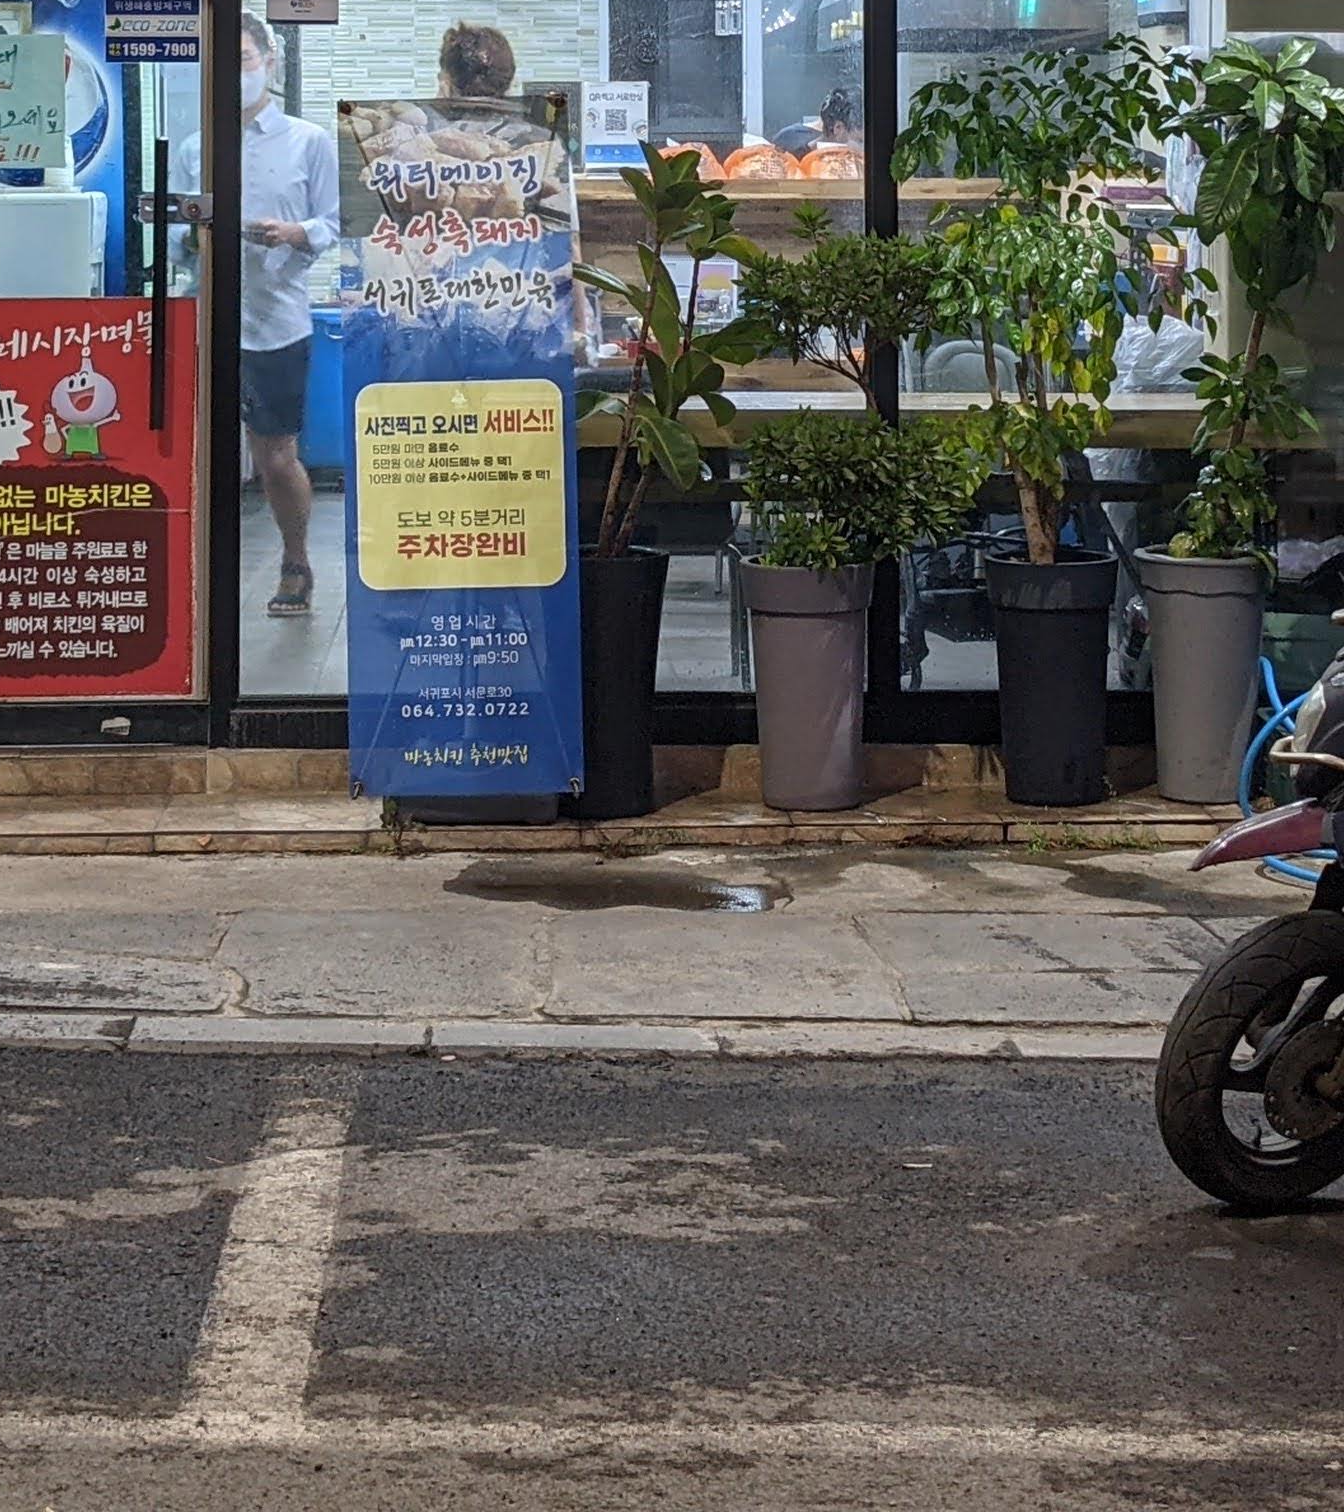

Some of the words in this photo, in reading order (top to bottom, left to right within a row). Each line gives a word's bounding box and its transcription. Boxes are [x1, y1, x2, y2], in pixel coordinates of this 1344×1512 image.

[121, 19, 197, 33] eco-zone
[122, 42, 197, 57] 1599-7908
[369, 155, 541, 200] 워터에이징
[369, 209, 540, 255] 숙성흑돼지
[364, 415, 428, 437] 사진찍고
[432, 413, 479, 436] 오시면
[483, 408, 555, 435] 서비스!!
[372, 443, 401, 455] 5만원
[427, 442, 460, 454] 음료수
[372, 457, 401, 470] 5만원
[404, 457, 425, 469] 이상
[427, 456, 479, 468] 사이드메뉴
[368, 472, 402, 485] 10만원
[404, 472, 426, 484] 이상
[44, 482, 153, 508] 마농치킨은
[397, 510, 434, 529] 도보
[437, 509, 456, 528] 약
[459, 508, 526, 527] 5분거리
[26, 543, 70, 561] 마늘을
[71, 543, 129, 561] 주원료로
[131, 542, 148, 560] 한
[397, 531, 527, 560] 주차장완비
[46, 568, 77, 586] 이상
[84, 567, 147, 585] 숙성하고
[7, 593, 24, 611] 후
[27, 592, 71, 611] 비로소
[76, 591, 149, 611] 튀겨내므로
[4, 616, 49, 635] 배어져
[53, 616, 96, 634] 치킨의
[101, 615, 145, 634] 육질이
[430, 614, 498, 631] 영업시간
[38, 641, 54, 659] 수
[58, 640, 118, 659] 있습니다.
[408, 652, 464, 668] 마지막입장
[418, 687, 462, 701] 서귀포시
[400, 701, 530, 719] 064.732.0722
[403, 746, 464, 768] 마농치킨
[469, 743, 529, 765] 추천맛집
